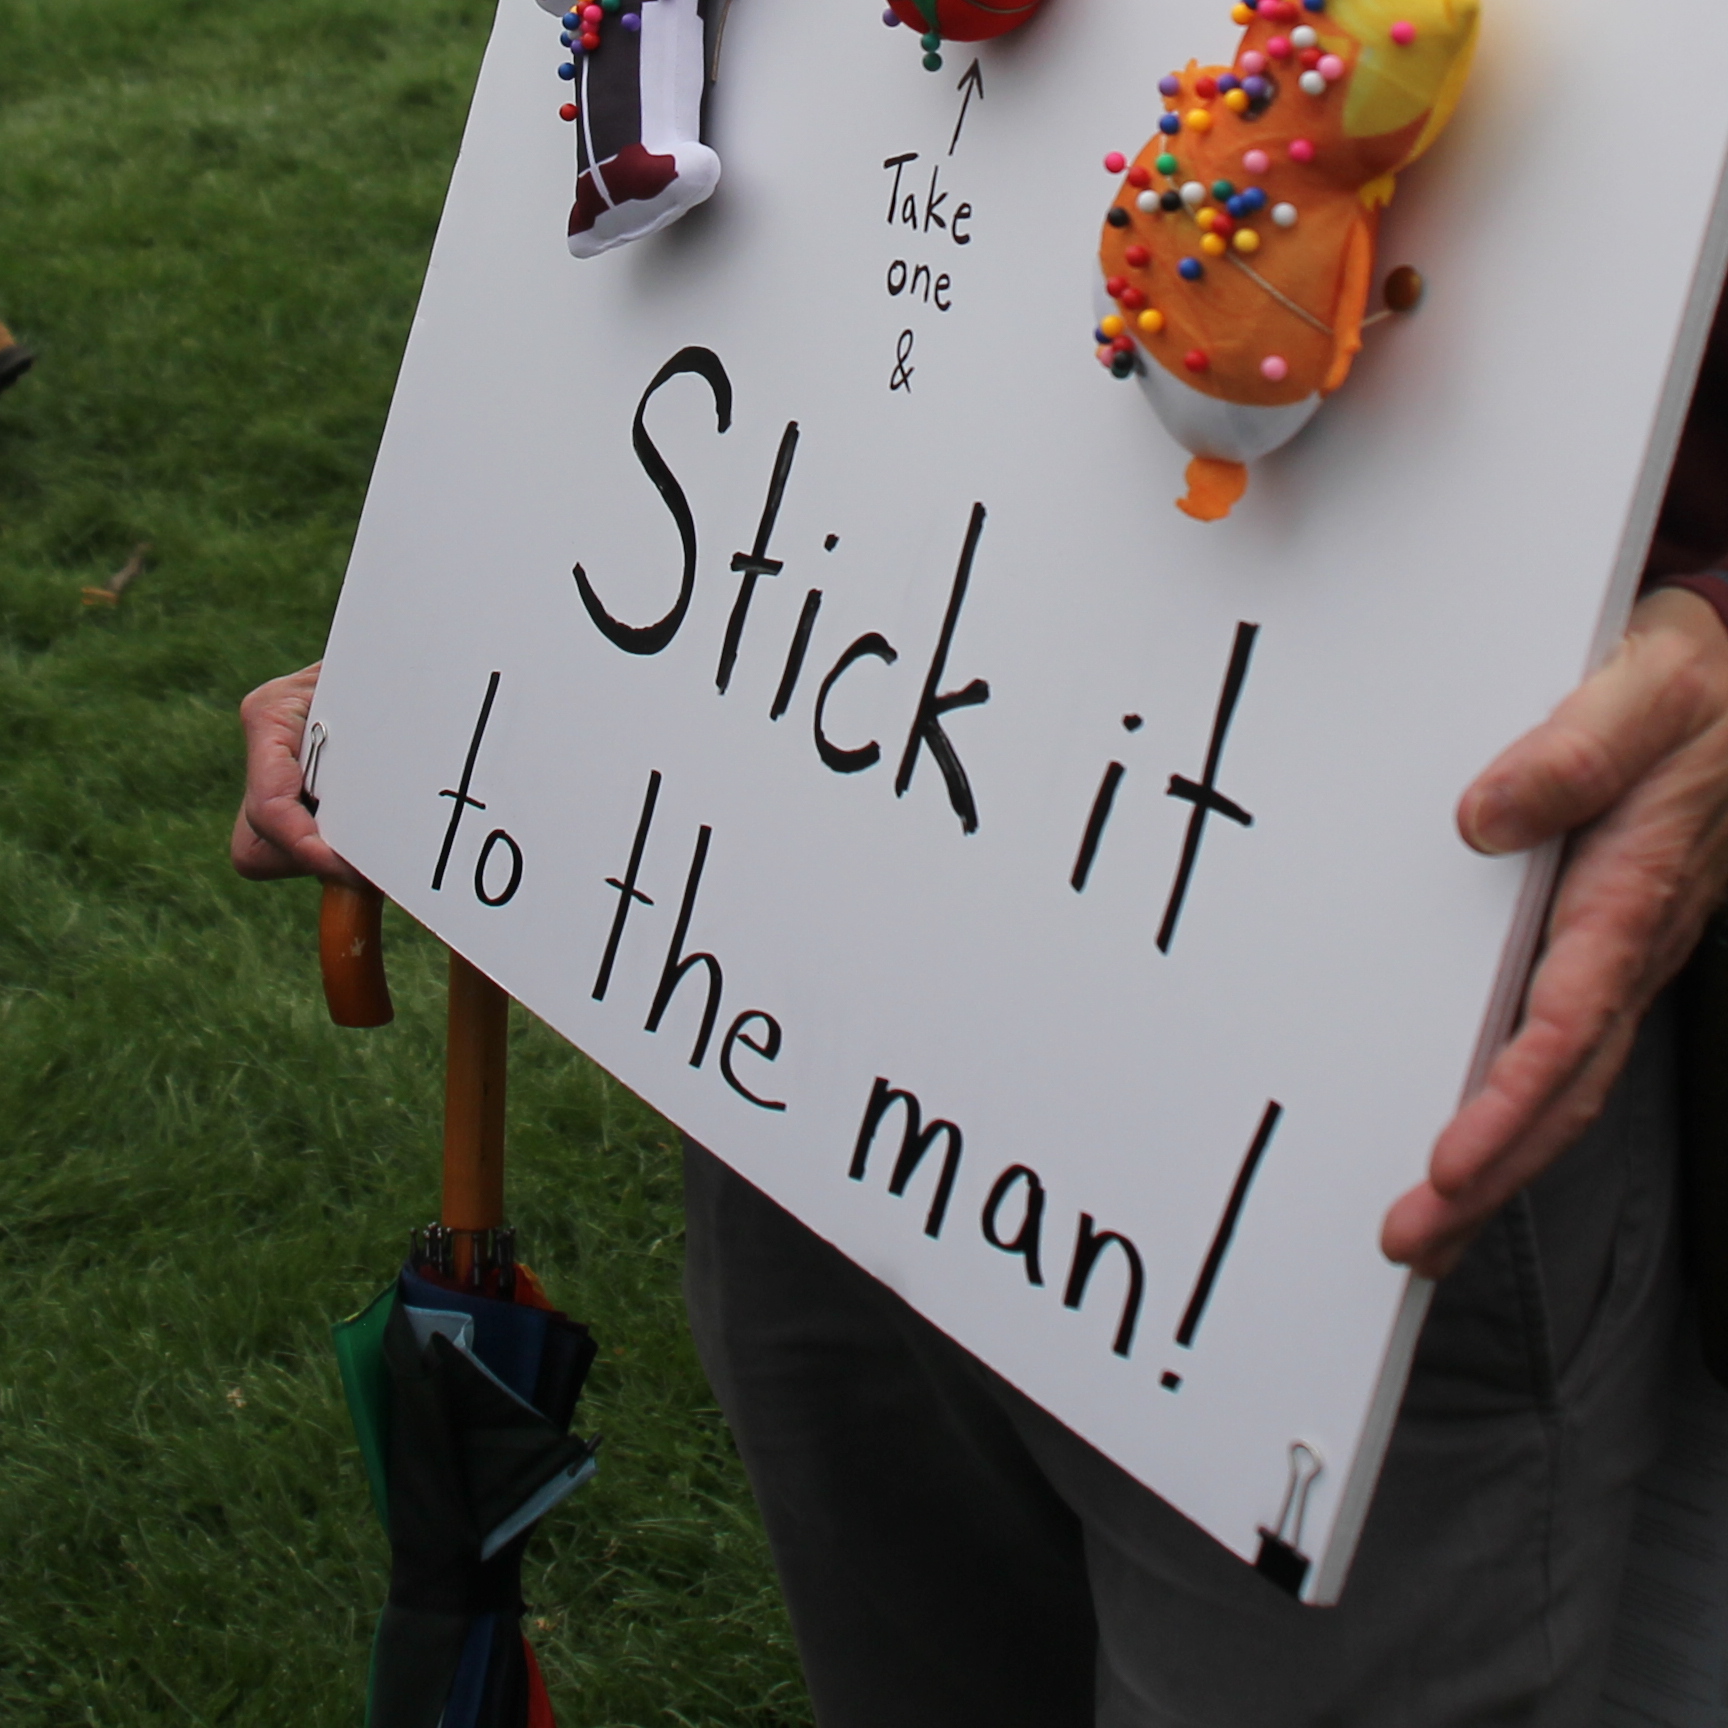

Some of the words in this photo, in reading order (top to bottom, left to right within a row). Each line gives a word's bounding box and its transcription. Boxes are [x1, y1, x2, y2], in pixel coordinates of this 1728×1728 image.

[883, 151, 973, 246] Take
[886, 255, 952, 313] one
[888, 329, 914, 394] &
[572, 344, 991, 834] Stick
[1070, 620, 1261, 954] it
[430, 670, 525, 908] to
[591, 769, 787, 1112] the
[847, 1076, 1282, 1392] man!
